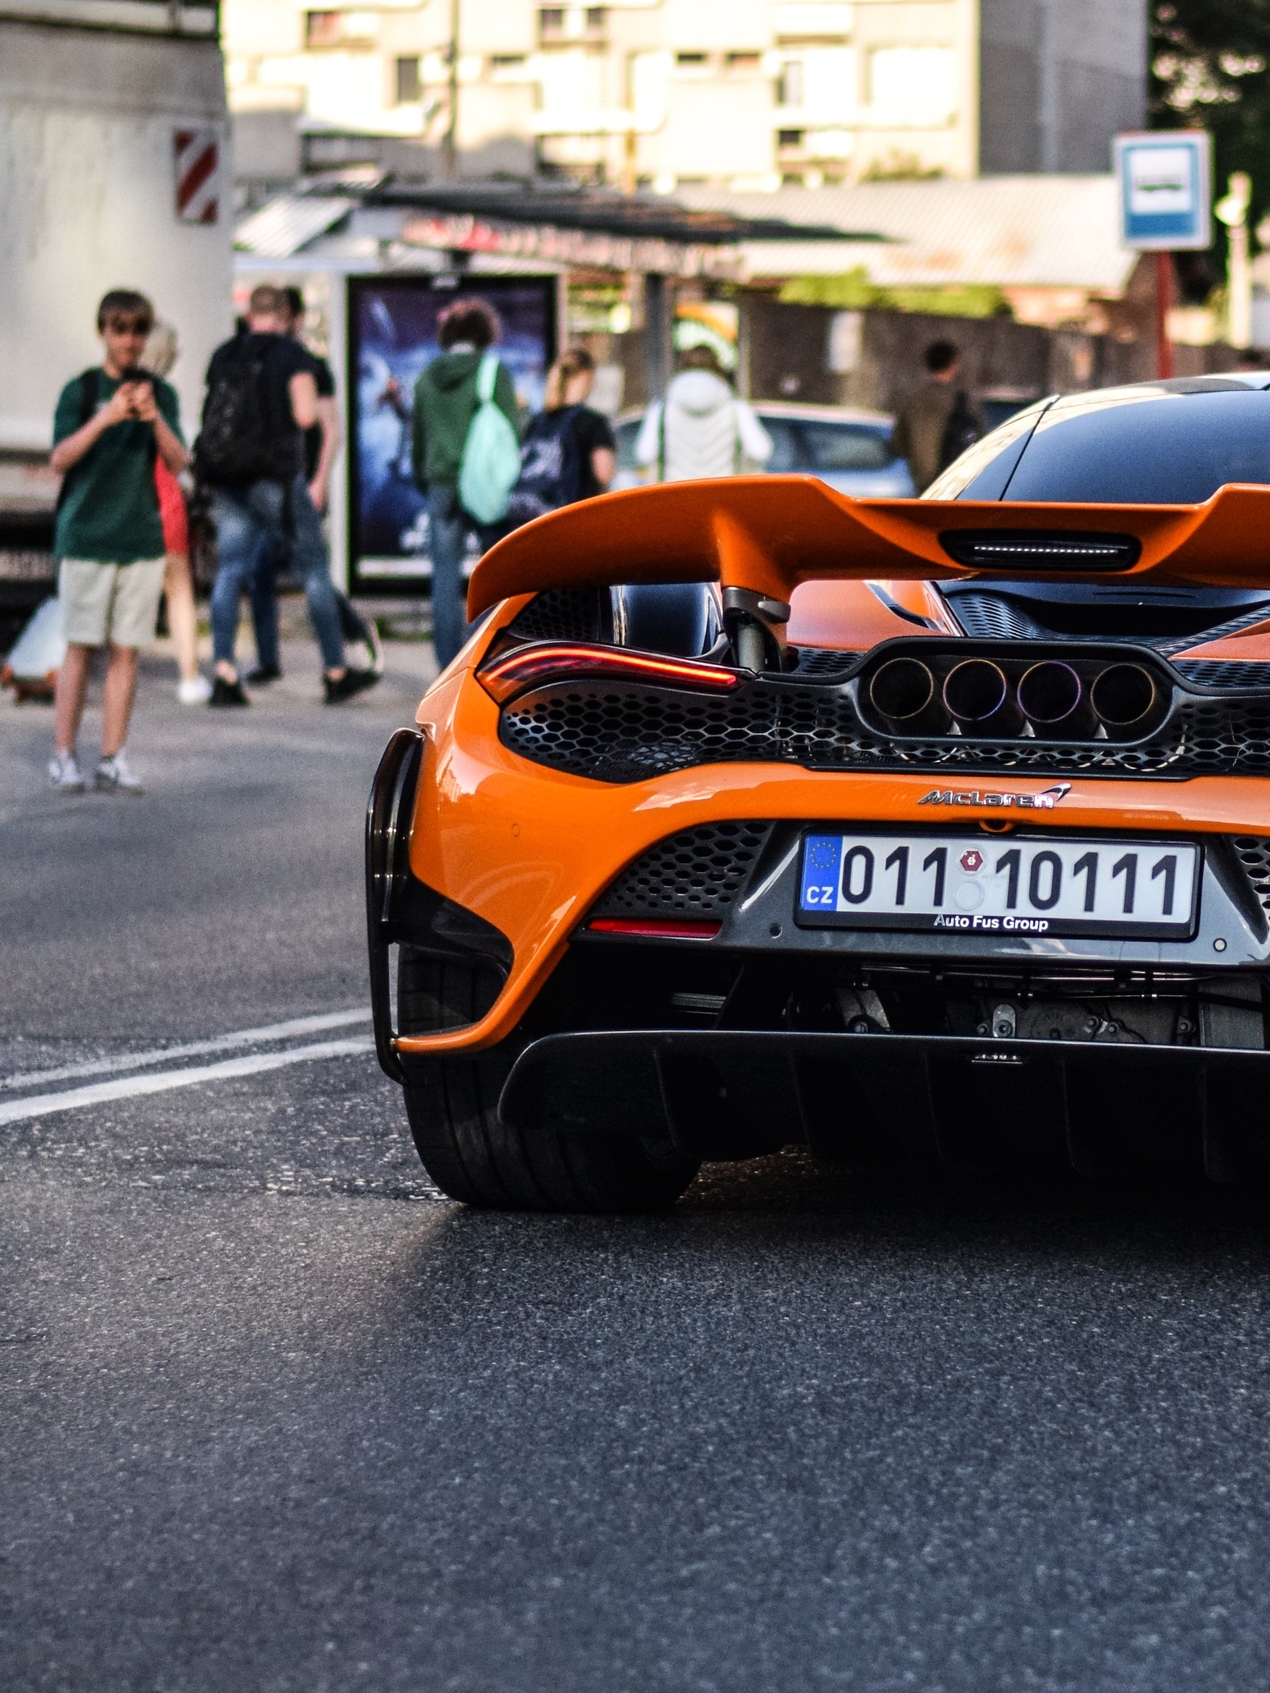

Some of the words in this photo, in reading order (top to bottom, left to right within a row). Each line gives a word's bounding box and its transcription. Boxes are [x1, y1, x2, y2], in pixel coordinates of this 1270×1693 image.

[917, 788, 1054, 809] McLaren
[841, 844, 949, 907] 011
[995, 848, 1178, 916] 10111
[806, 885, 834, 904] CZ
[933, 913, 970, 928] Auto
[972, 915, 1000, 929] Fus
[1002, 916, 1049, 933] Group
